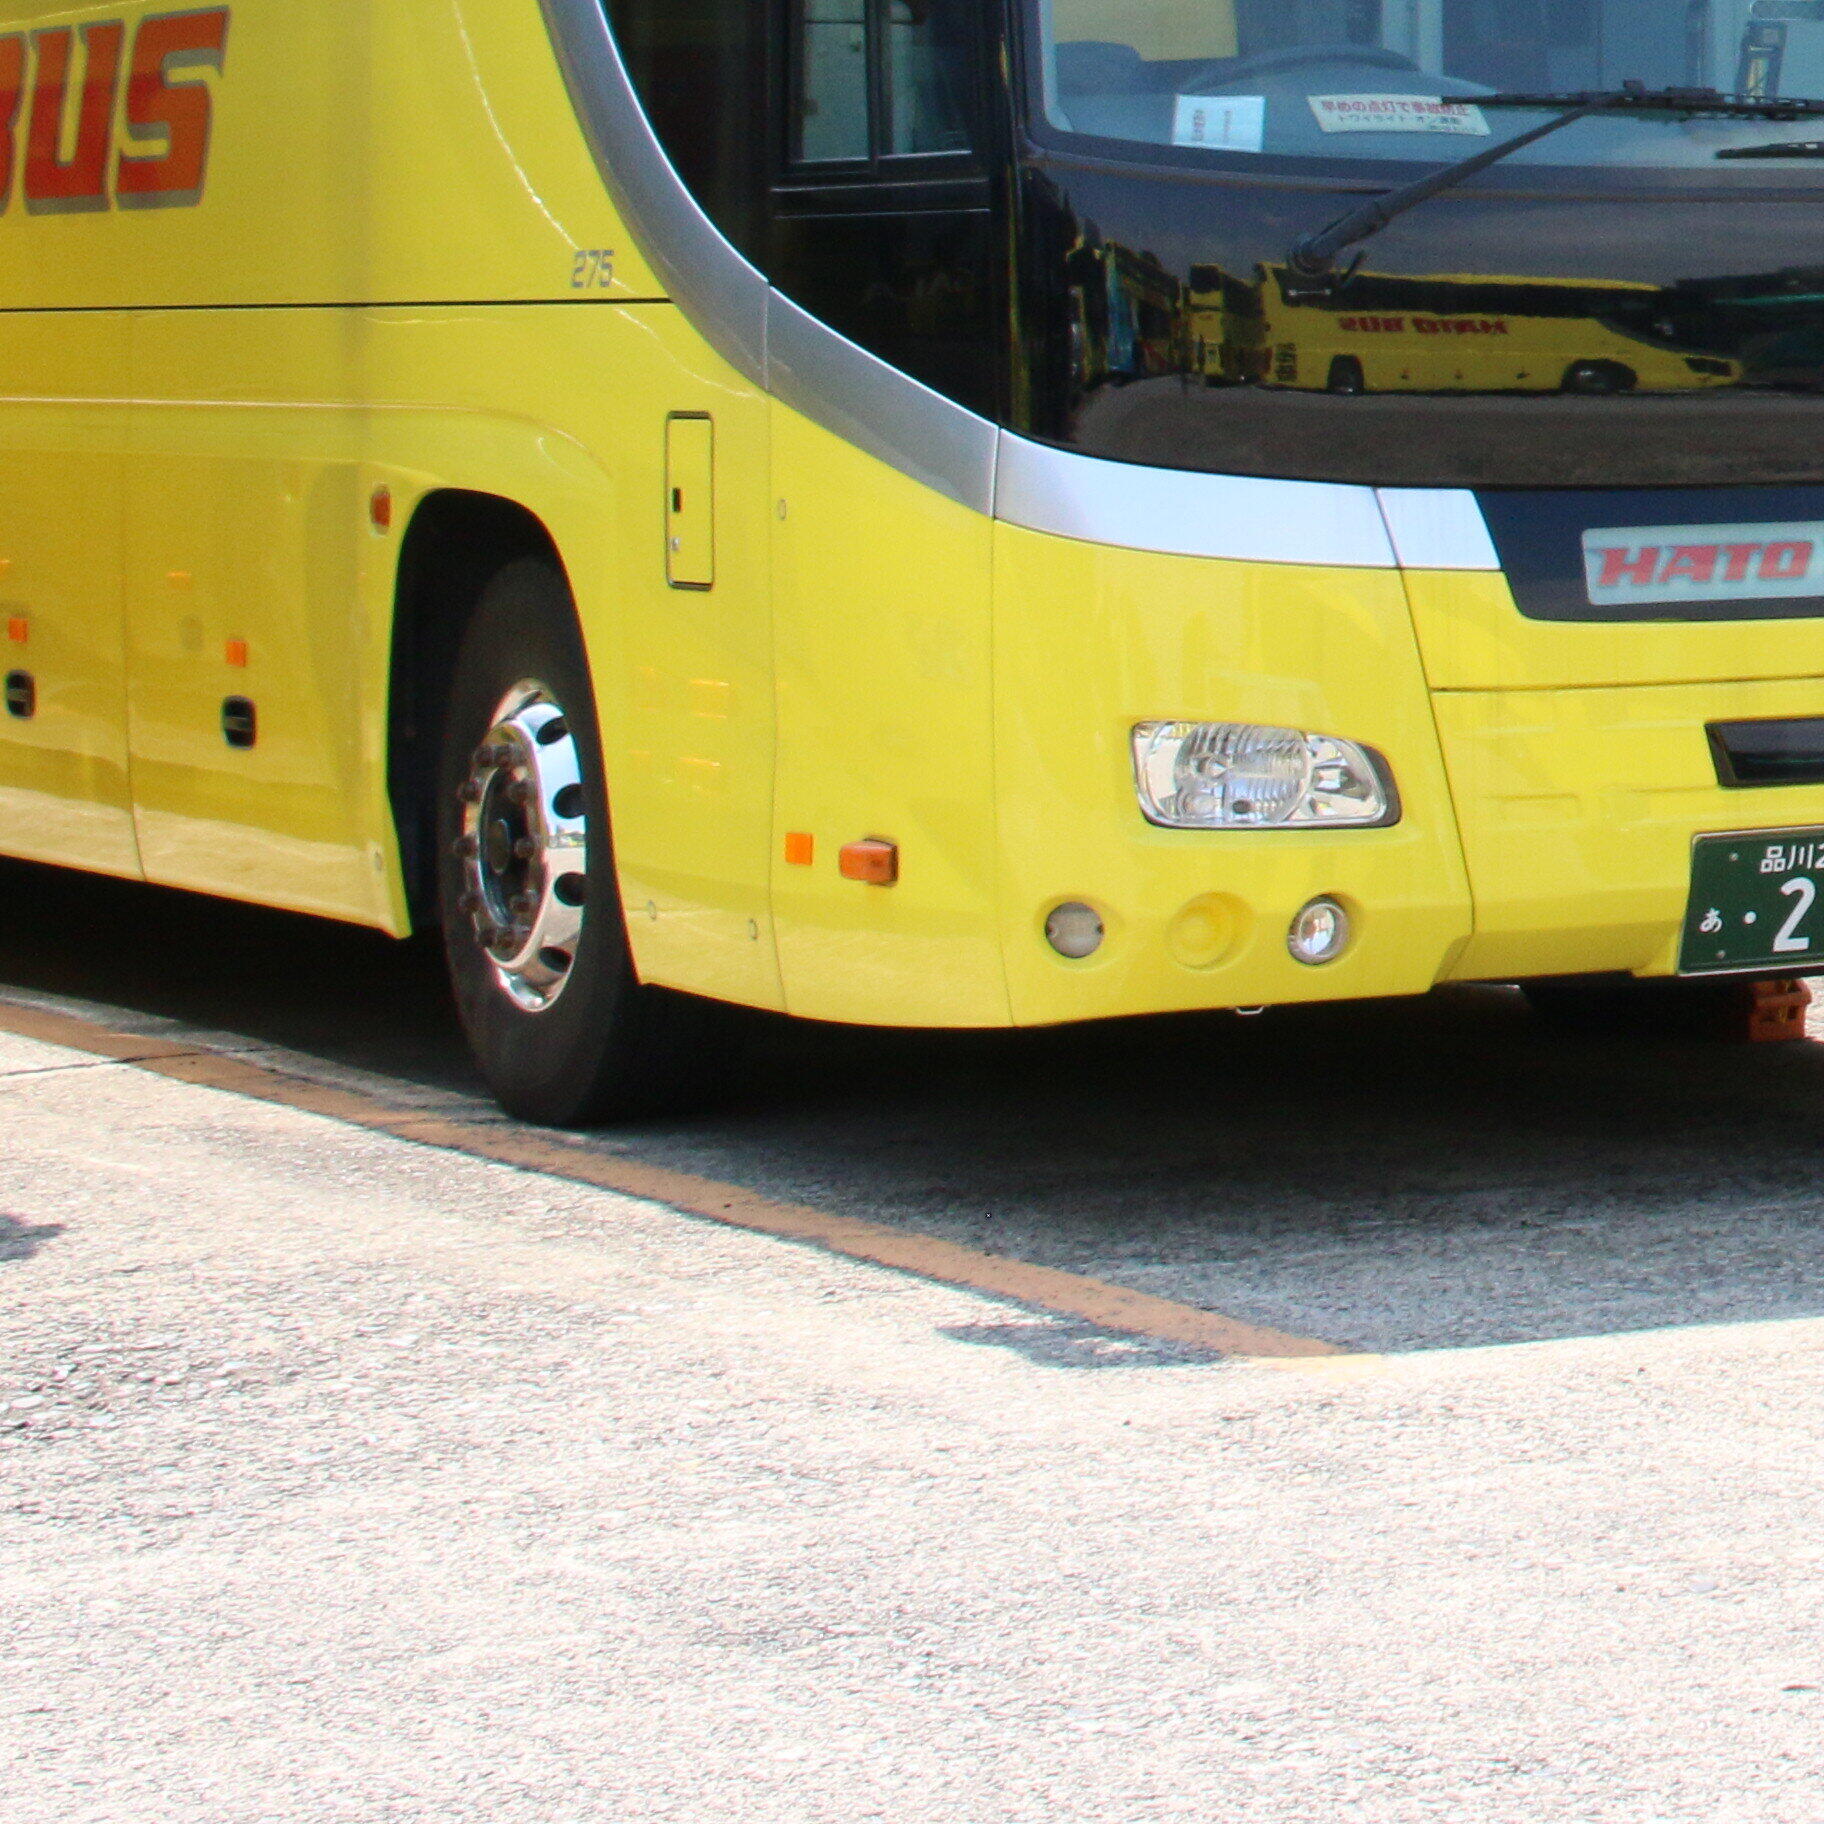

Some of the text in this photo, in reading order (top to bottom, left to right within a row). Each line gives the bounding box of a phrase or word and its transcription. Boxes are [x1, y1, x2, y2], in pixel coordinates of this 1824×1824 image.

[0, 5, 231, 217] US
[571, 249, 614, 288] 275
[1592, 540, 1813, 586] HATO
[1699, 907, 1723, 933] あ
